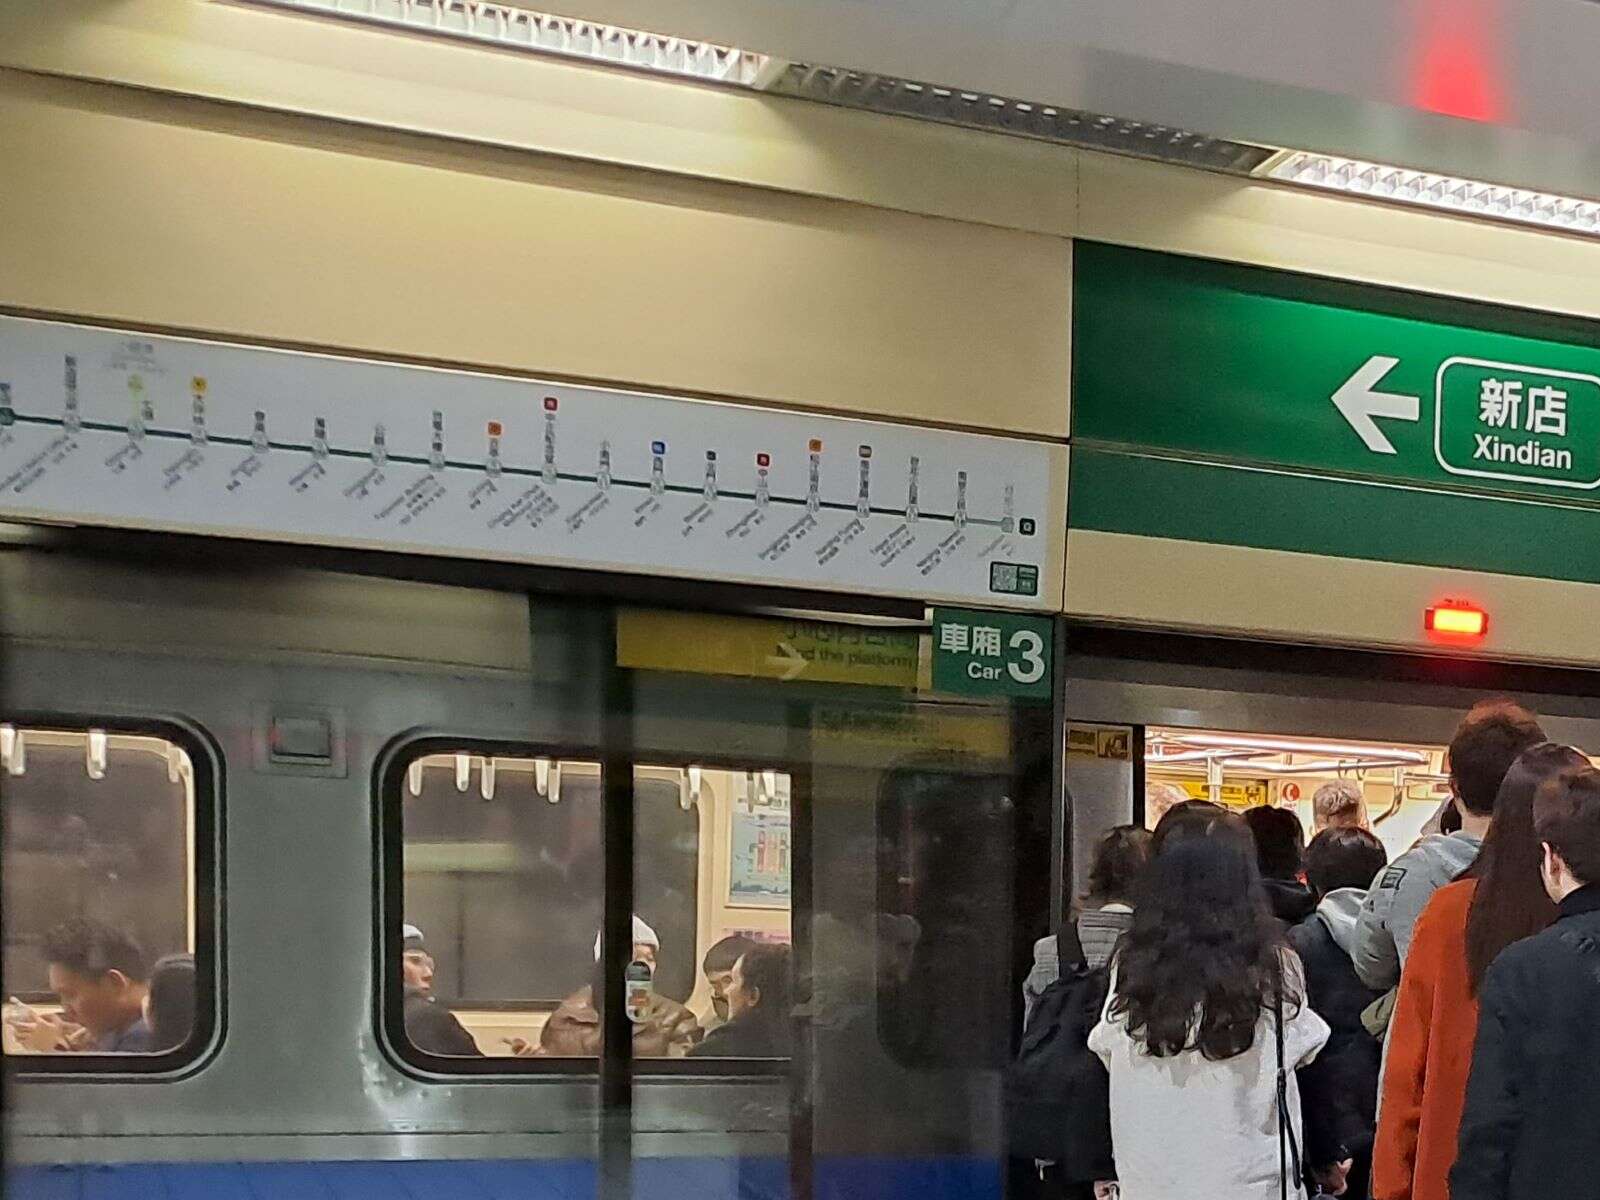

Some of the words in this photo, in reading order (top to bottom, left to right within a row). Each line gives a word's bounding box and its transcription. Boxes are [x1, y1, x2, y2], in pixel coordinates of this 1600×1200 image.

[1479, 378, 1567, 436] 新店
[1473, 434, 1571, 469] Xindian
[939, 623, 1001, 656] 車廂
[1007, 630, 1046, 684] 3
[968, 661, 1002, 680] Car
